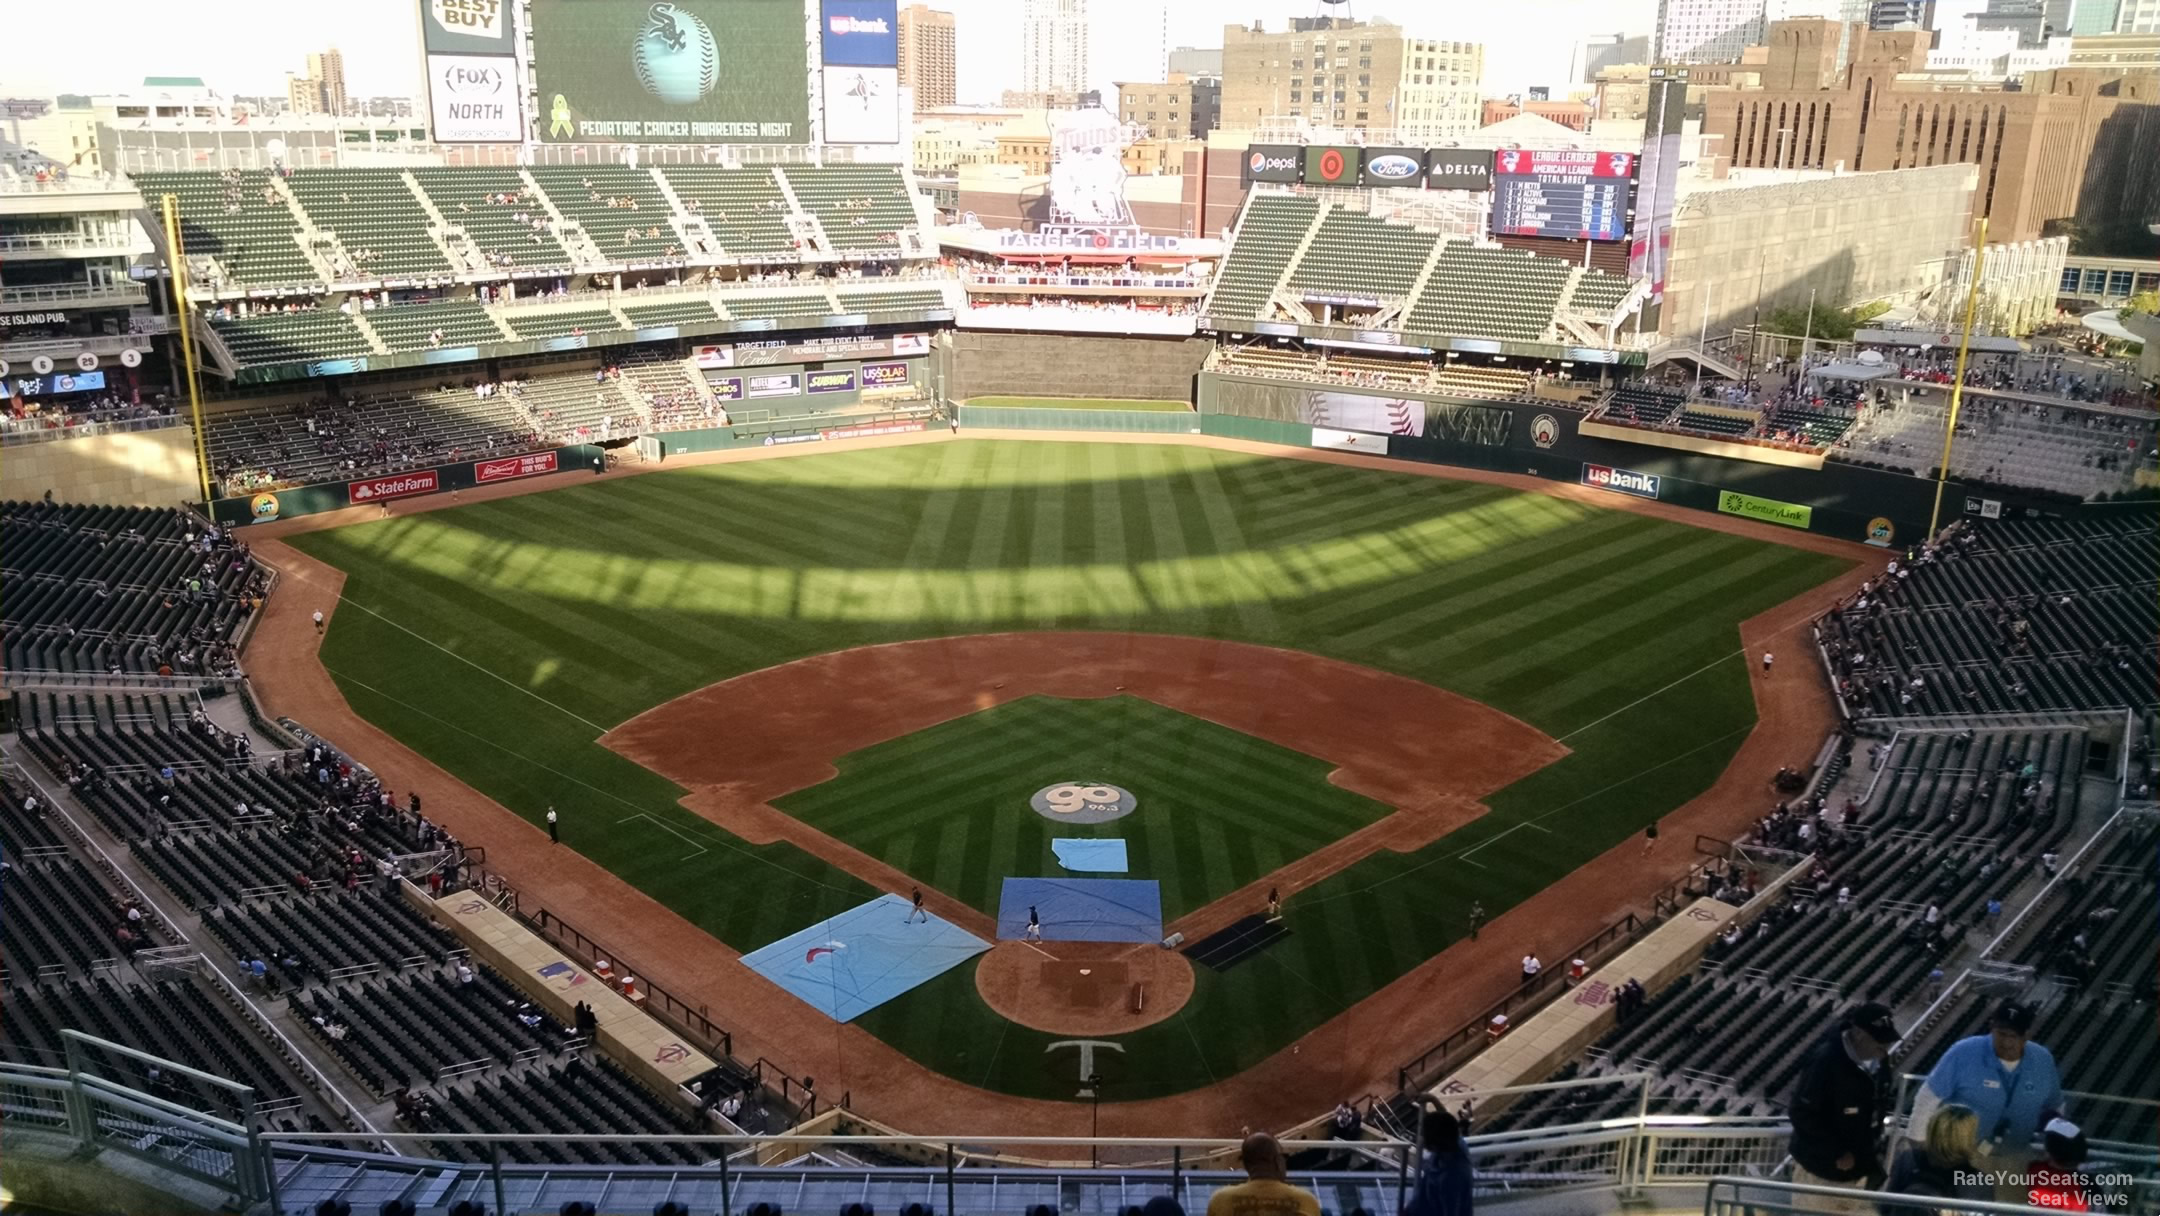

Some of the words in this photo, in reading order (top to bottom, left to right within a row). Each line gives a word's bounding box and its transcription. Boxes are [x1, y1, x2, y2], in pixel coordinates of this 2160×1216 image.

[445, 10, 494, 28] BUY
[457, 68, 490, 84] FOX
[449, 103, 503, 119] NORTH
[580, 121, 641, 136] PEDIATRIC
[644, 121, 689, 136] CANCER
[692, 122, 758, 136] AWARENESS
[760, 122, 793, 137] NIGHT
[1266, 156, 1297, 171] pepsi
[1532, 151, 1560, 162] LEAGUE
[1561, 152, 1598, 163] LEADERS
[1378, 160, 1409, 175] Ford
[1445, 164, 1487, 176] DELTA
[1532, 165, 1567, 174] AMERICAN
[1568, 165, 1595, 175] LEAGUE
[1001, 234, 1091, 248] TARGET
[1114, 236, 1181, 250] FIELD
[13, 313, 45, 325] ISLAND
[46, 312, 66, 324] PUB
[736, 342, 765, 350] TARGET
[766, 340, 786, 349] FIELD
[82, 357, 94, 367] 29
[128, 354, 134, 363] 3
[40, 361, 46, 370] 6
[809, 374, 853, 387] SUBWAY
[521, 456, 533, 465] THIS
[534, 454, 552, 464] BUD'S
[521, 465, 533, 474] FOR
[534, 463, 547, 472] YOU.
[1745, 502, 1802, 521] CenturyLink
